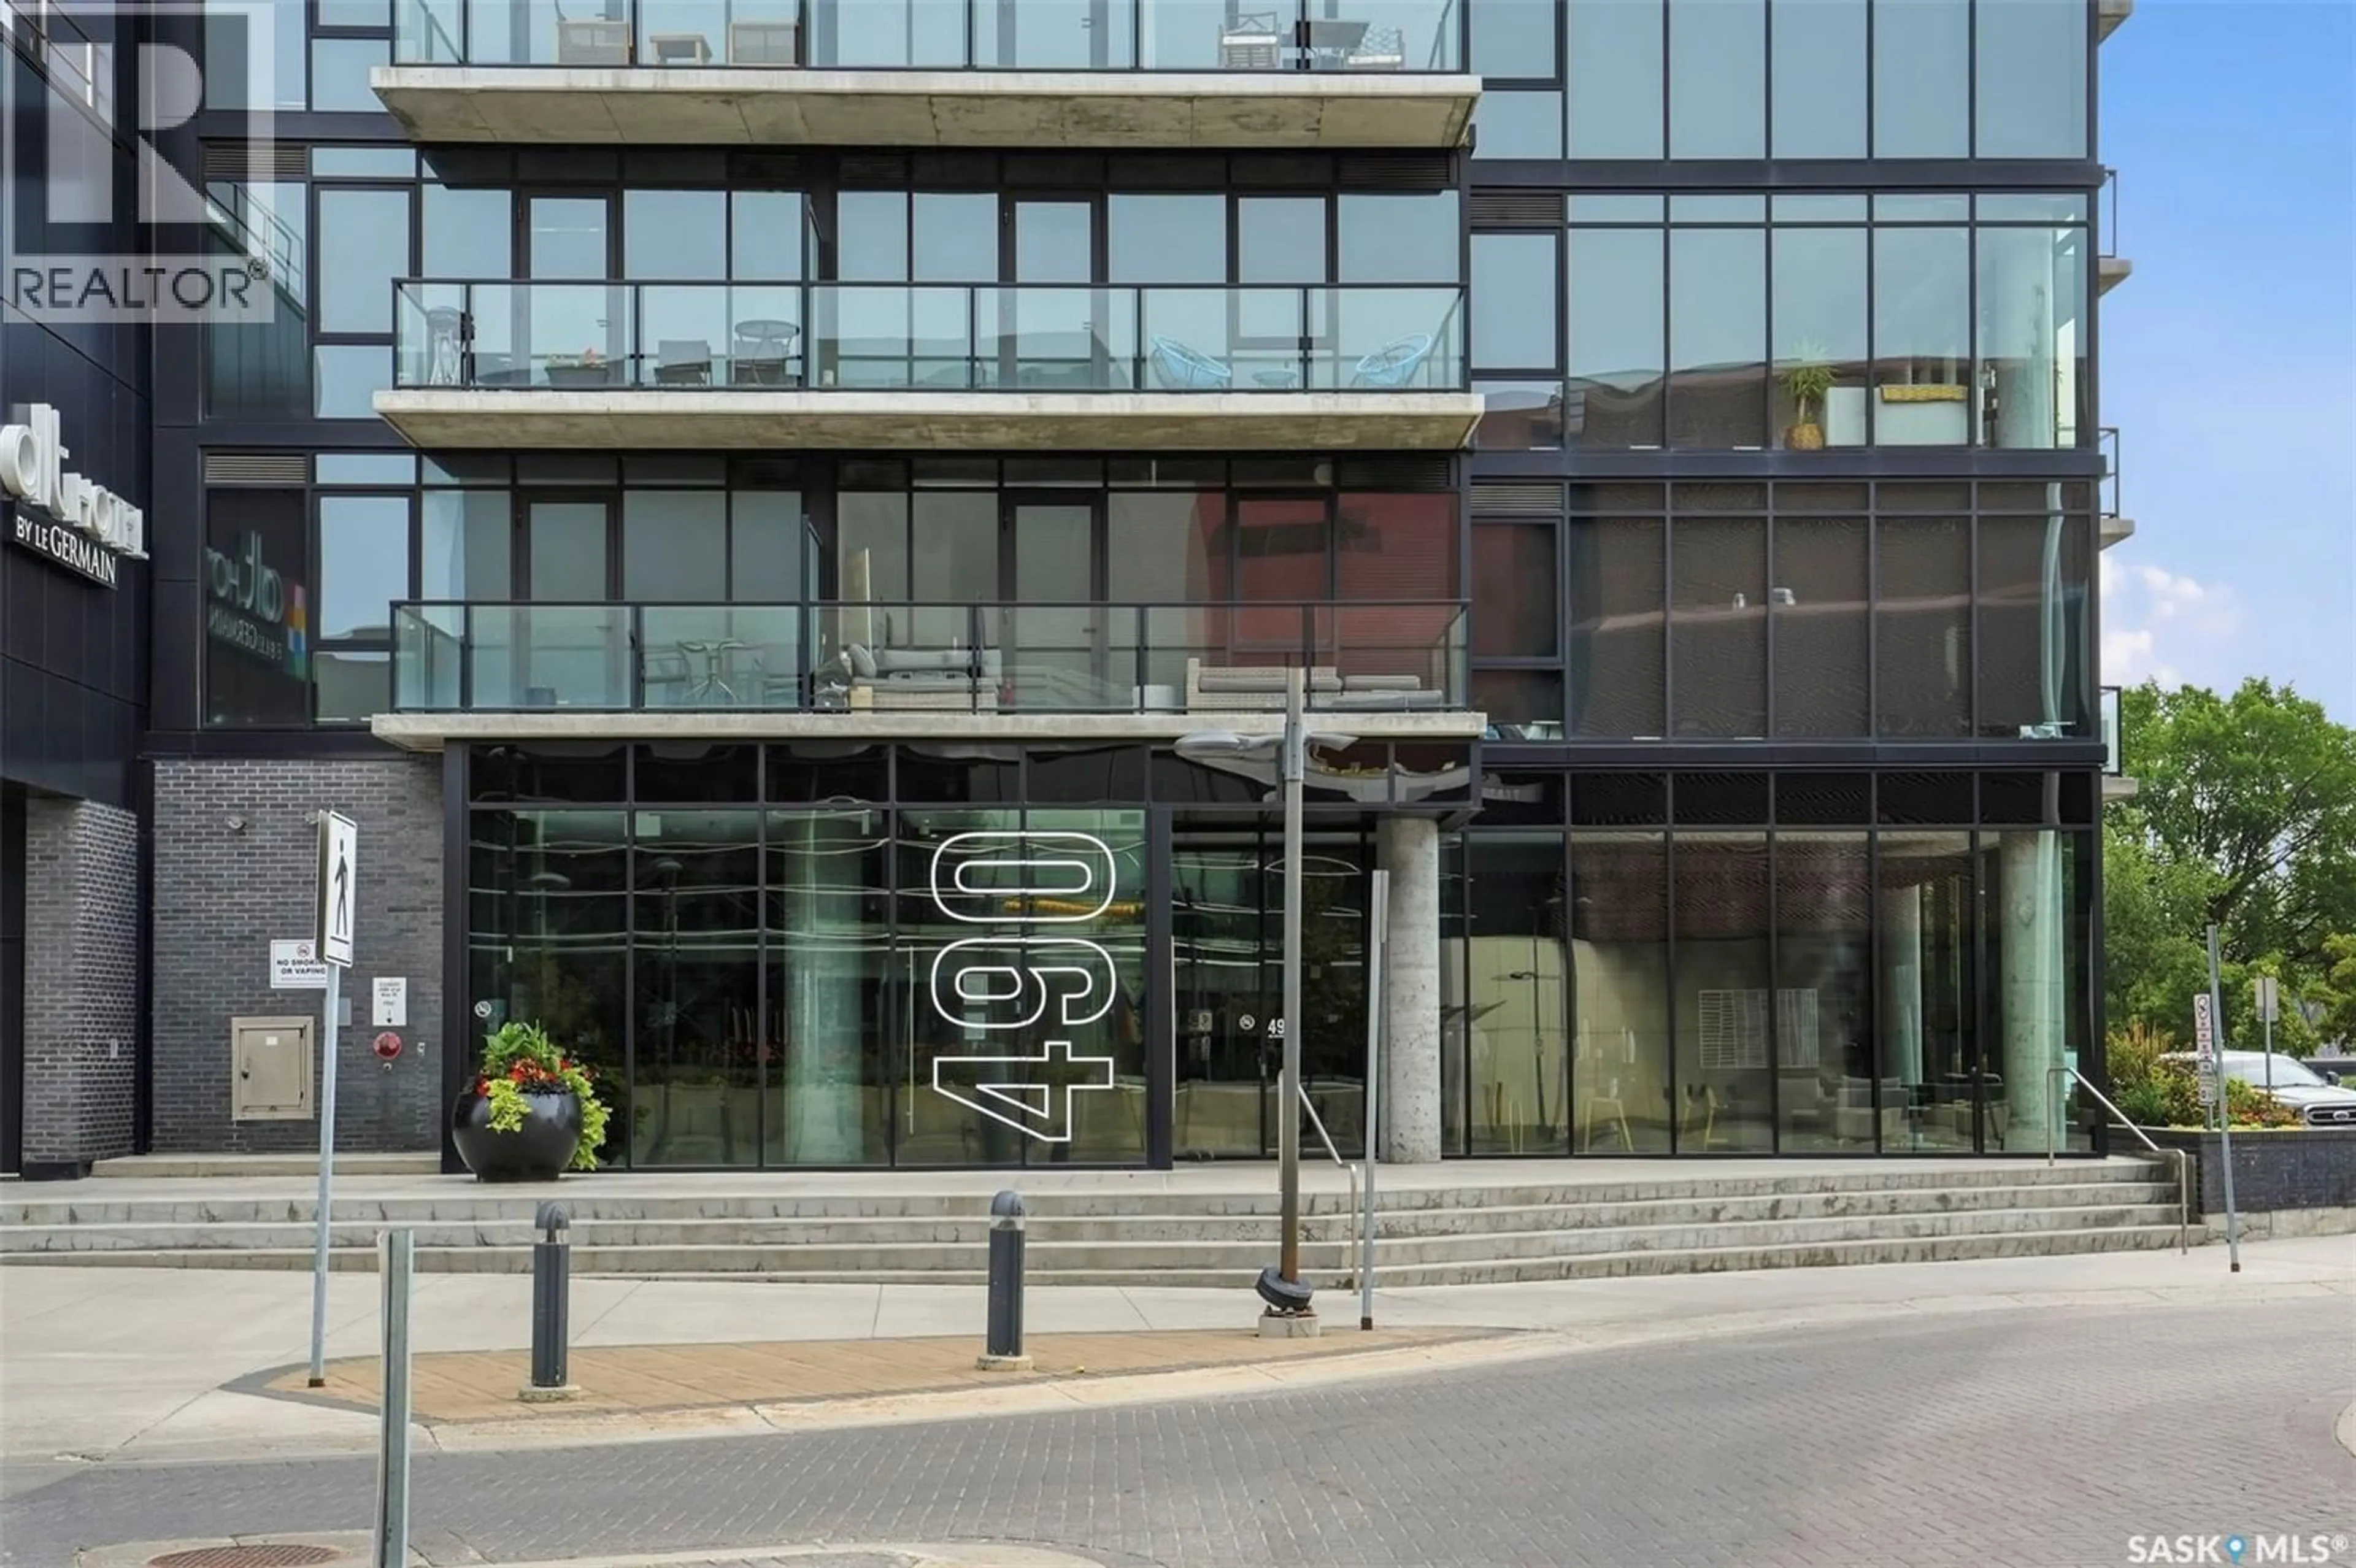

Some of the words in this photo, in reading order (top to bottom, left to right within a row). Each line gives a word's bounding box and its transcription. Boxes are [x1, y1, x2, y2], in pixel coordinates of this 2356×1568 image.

[16, 515, 33, 543] BY
[35, 525, 48, 551] LE
[50, 525, 117, 585] GERMAIN
[931, 832, 1116, 1142] 490
[1267, 1018, 1285, 1034] 49
